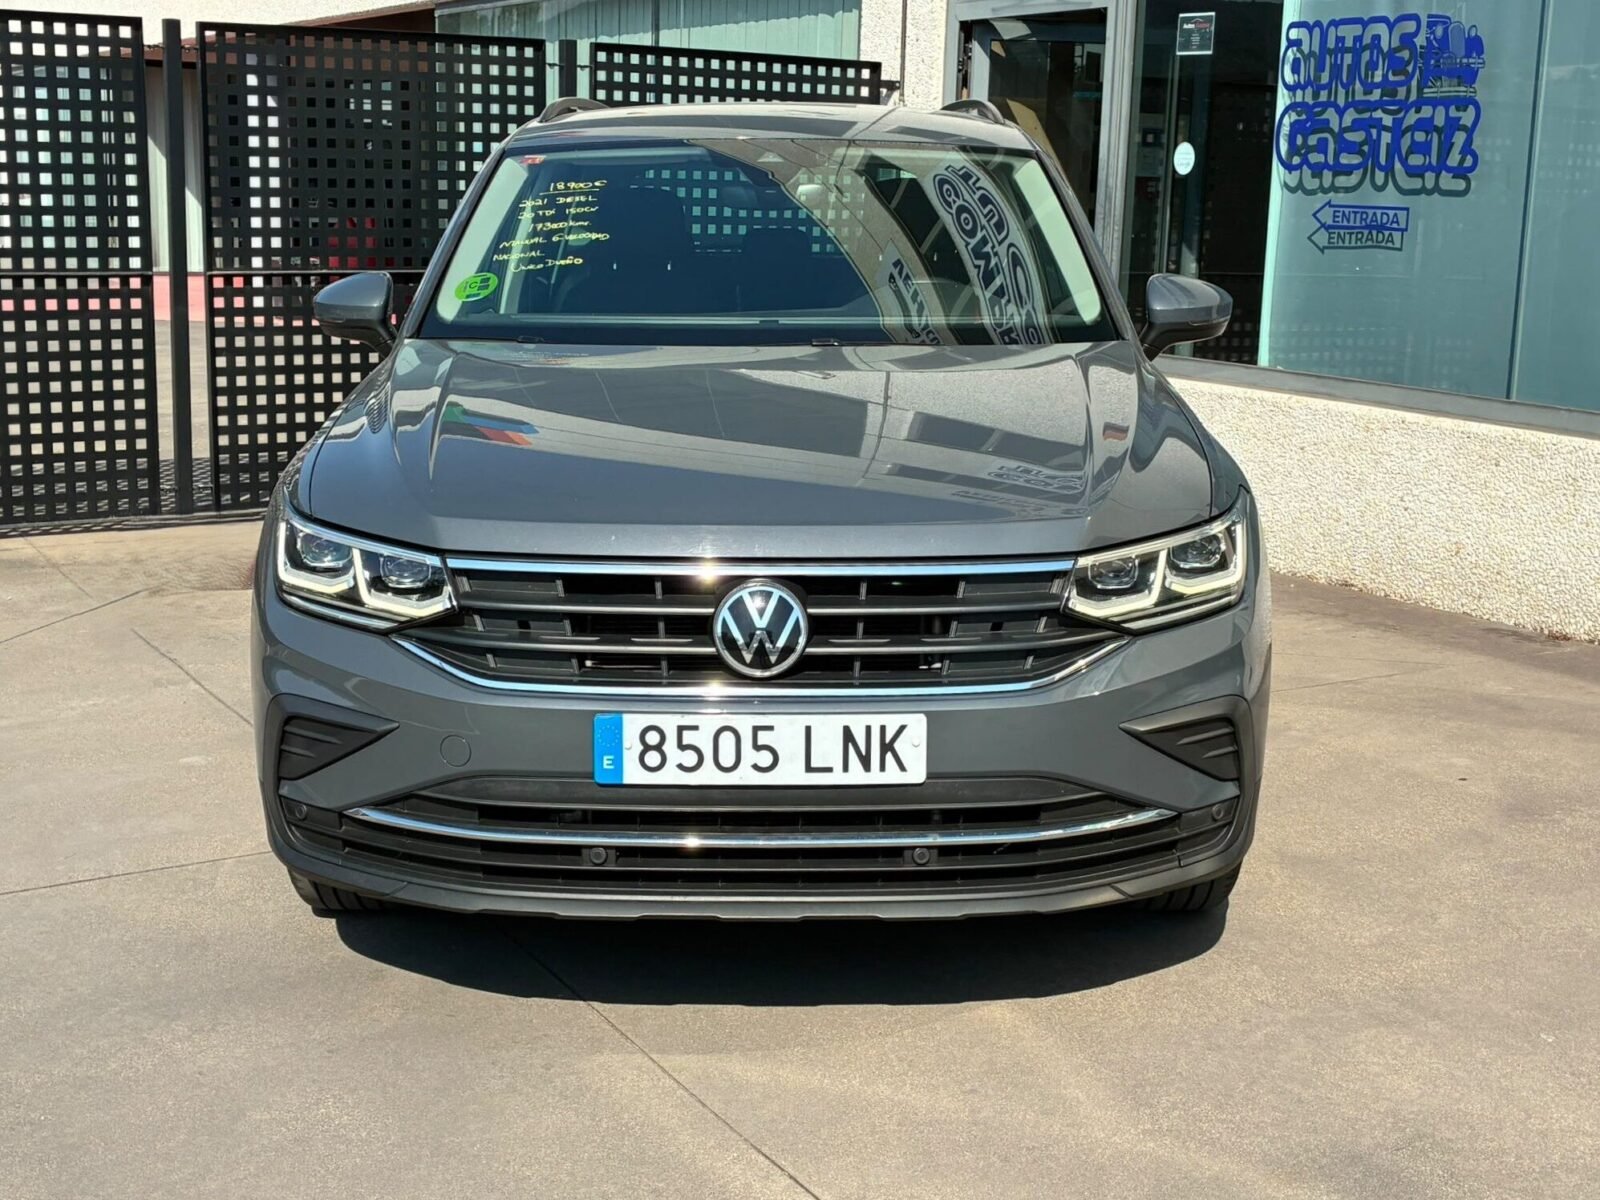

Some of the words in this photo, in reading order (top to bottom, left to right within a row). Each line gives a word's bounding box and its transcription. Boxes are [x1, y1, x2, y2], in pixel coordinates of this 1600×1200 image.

[1332, 209, 1400, 226] ENTRADA
[638, 724, 780, 774] 8505
[804, 724, 908, 773] LNK
[602, 755, 615, 769] E
